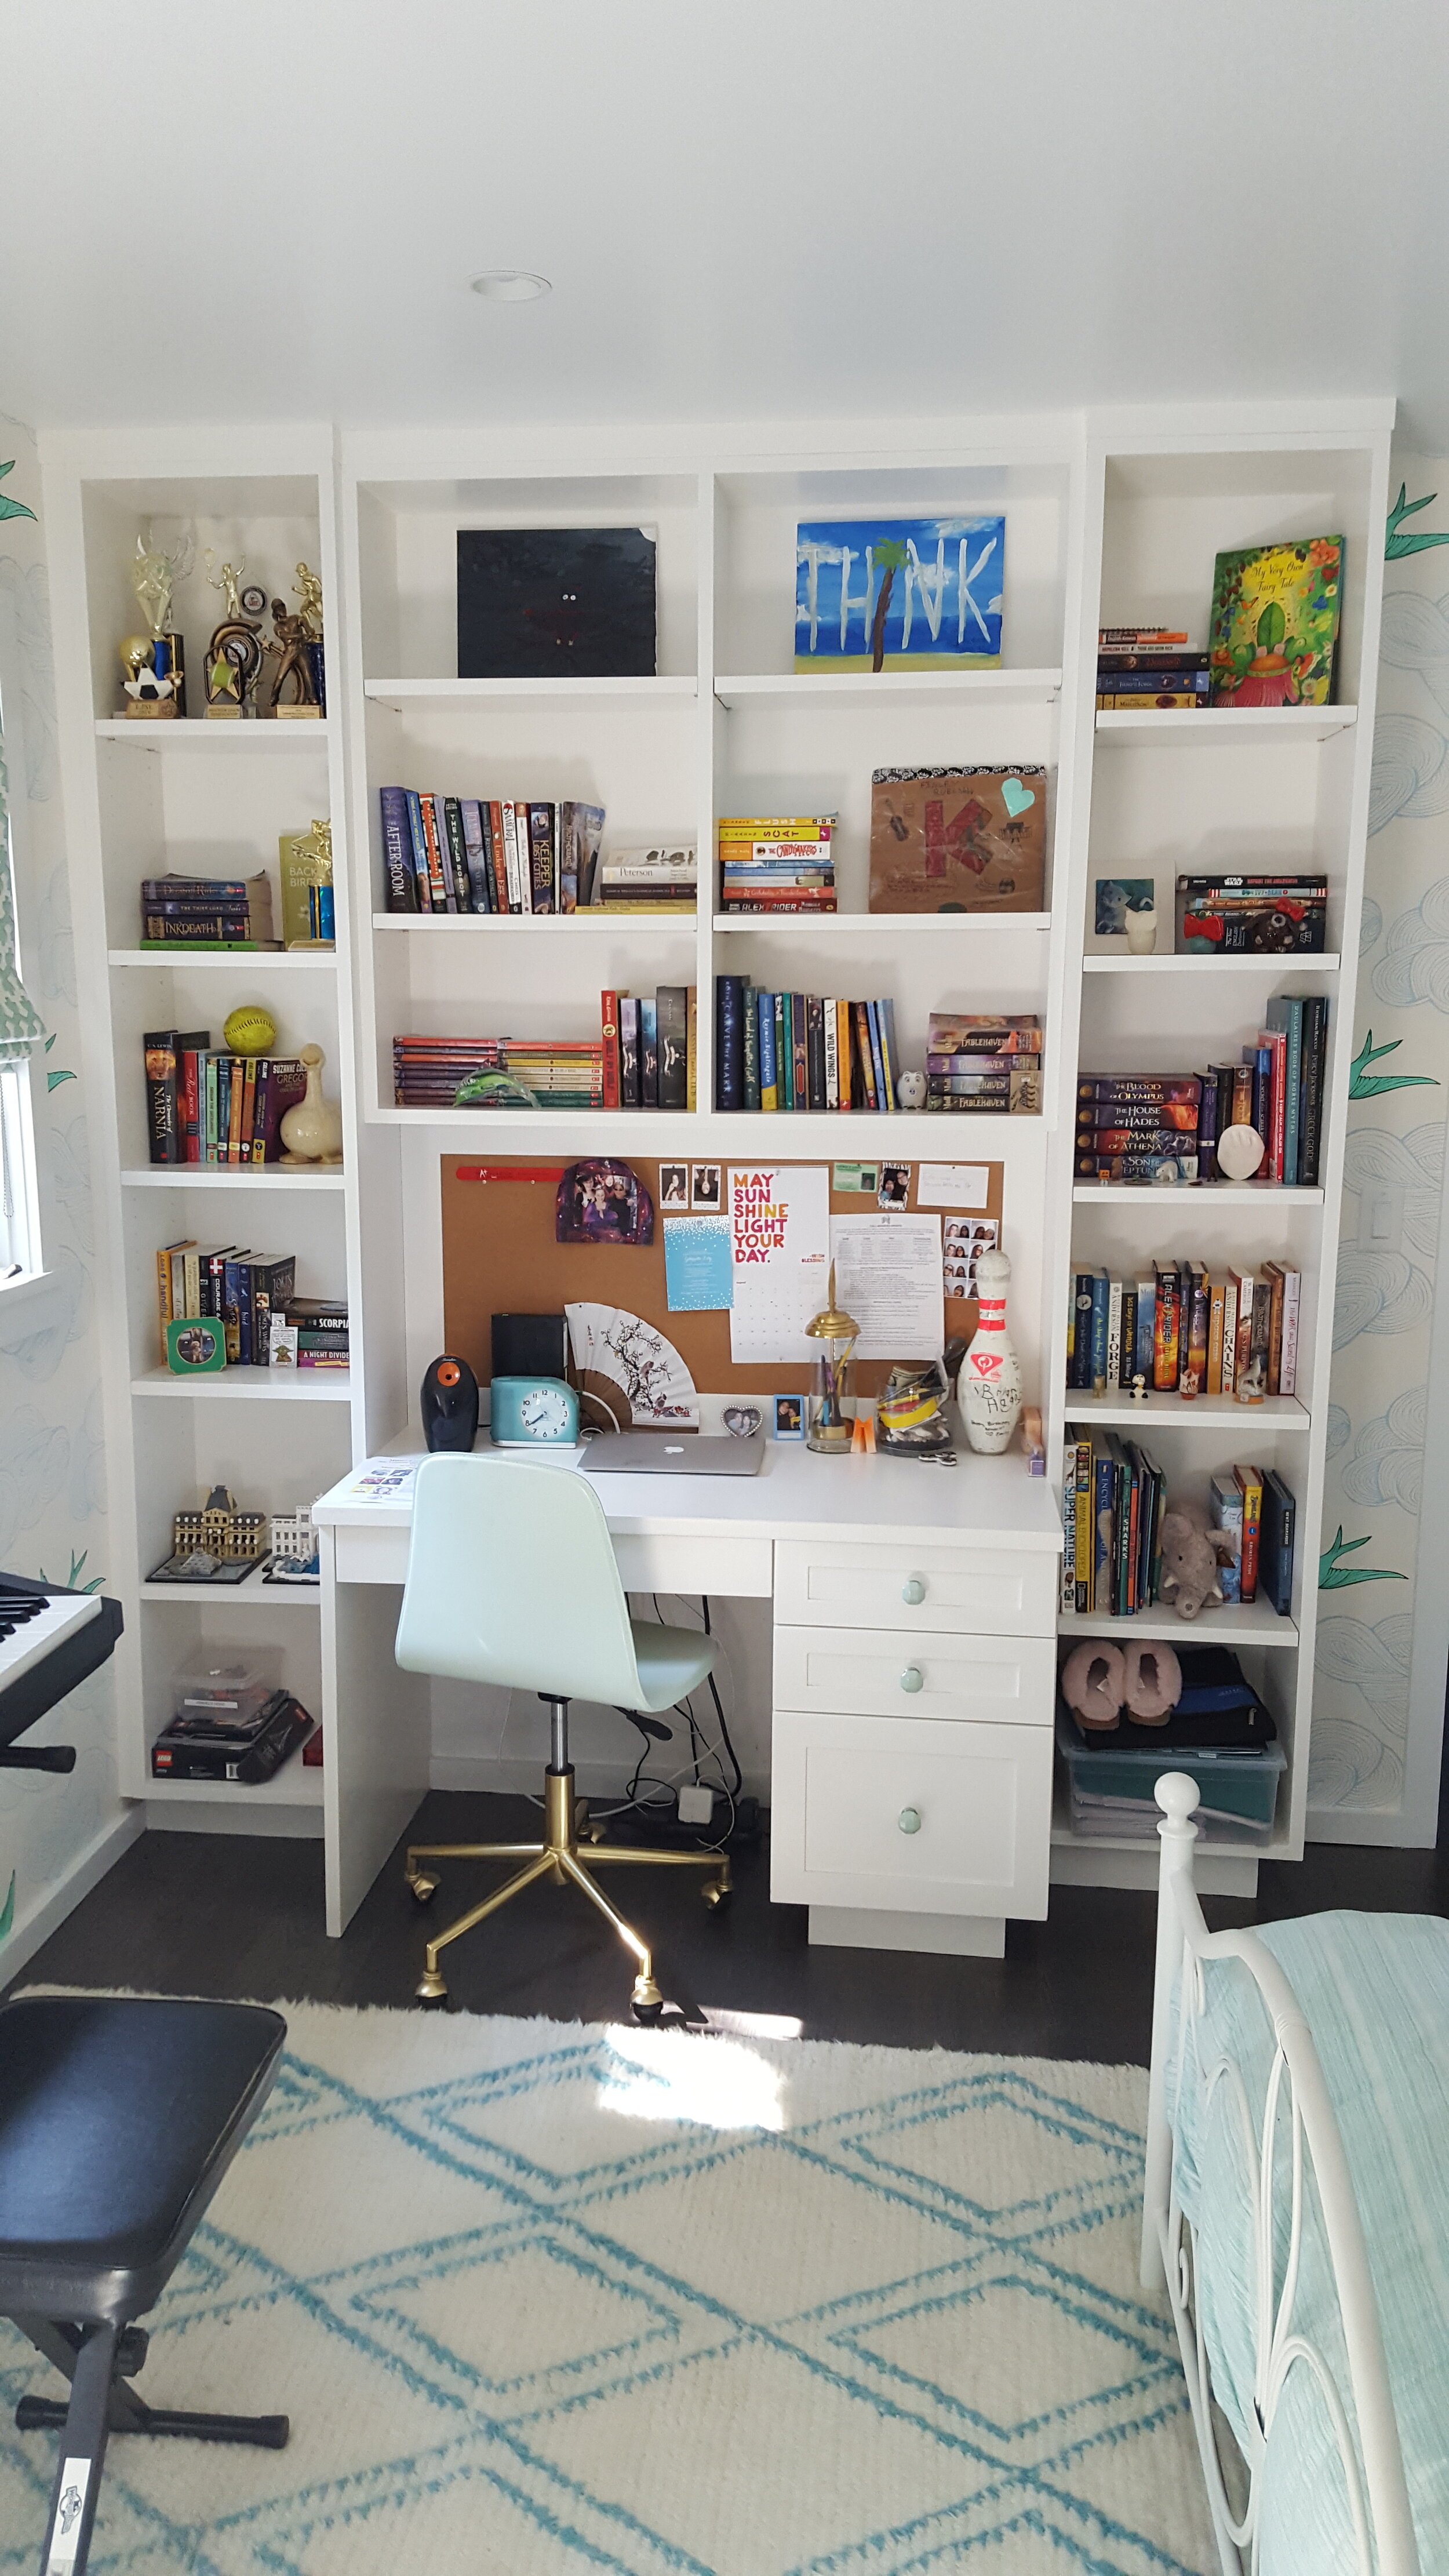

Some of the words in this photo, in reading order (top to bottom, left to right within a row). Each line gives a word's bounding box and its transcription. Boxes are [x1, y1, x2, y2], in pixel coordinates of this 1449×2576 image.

[1253, 566, 1265, 580] My
[1270, 565, 1284, 577] Very
[1258, 581, 1276, 594] Fairy
[1281, 577, 1294, 588] Tale
[532, 840, 541, 862] LOST
[776, 843, 817, 858] CANDYMAKERS
[452, 837, 461, 862] WILD
[457, 864, 466, 897] ROBOT
[540, 840, 551, 888] KEEPER
[533, 863, 541, 890] CITIES
[620, 867, 653, 877] Peterson
[742, 903, 764, 911] ALEX
[771, 903, 797, 911] RIDER
[165, 921, 215, 935] INKDEATH
[723, 1004, 731, 1039] CARVE
[827, 1033, 835, 1051] WILD
[272, 1064, 296, 1074] SUZANNE
[763, 1043, 771, 1083] Nightingale
[828, 1053, 836, 1078] WINGS
[1126, 1082, 1162, 1091] BLOOD
[1117, 1092, 1164, 1100] OLYMPUS
[154, 1086, 167, 1140] NARNIA
[1128, 1105, 1162, 1116] HOUSE
[1124, 1117, 1160, 1127] HADES
[1127, 1130, 1160, 1141] MARK
[1120, 1141, 1162, 1151] ATHENA
[1128, 1156, 1151, 1167] SON
[734, 1173, 774, 1188] MAY
[733, 1188, 771, 1203] SUN
[734, 1203, 789, 1218] SHINE
[734, 1218, 788, 1233] LIGHT
[734, 1234, 785, 1249] YOUR
[735, 1249, 771, 1263] DAY.
[1163, 1283, 1173, 1308] ALEX
[1163, 1317, 1173, 1343] RIDER
[1288, 1316, 1297, 1331] WAR
[1108, 1333, 1119, 1380] FORGE
[1223, 1330, 1235, 1378] CHAINS
[1064, 1485, 1076, 1522] SUPER
[1078, 1496, 1086, 1525] ANIMAL
[1064, 1525, 1076, 1568] NATURE
